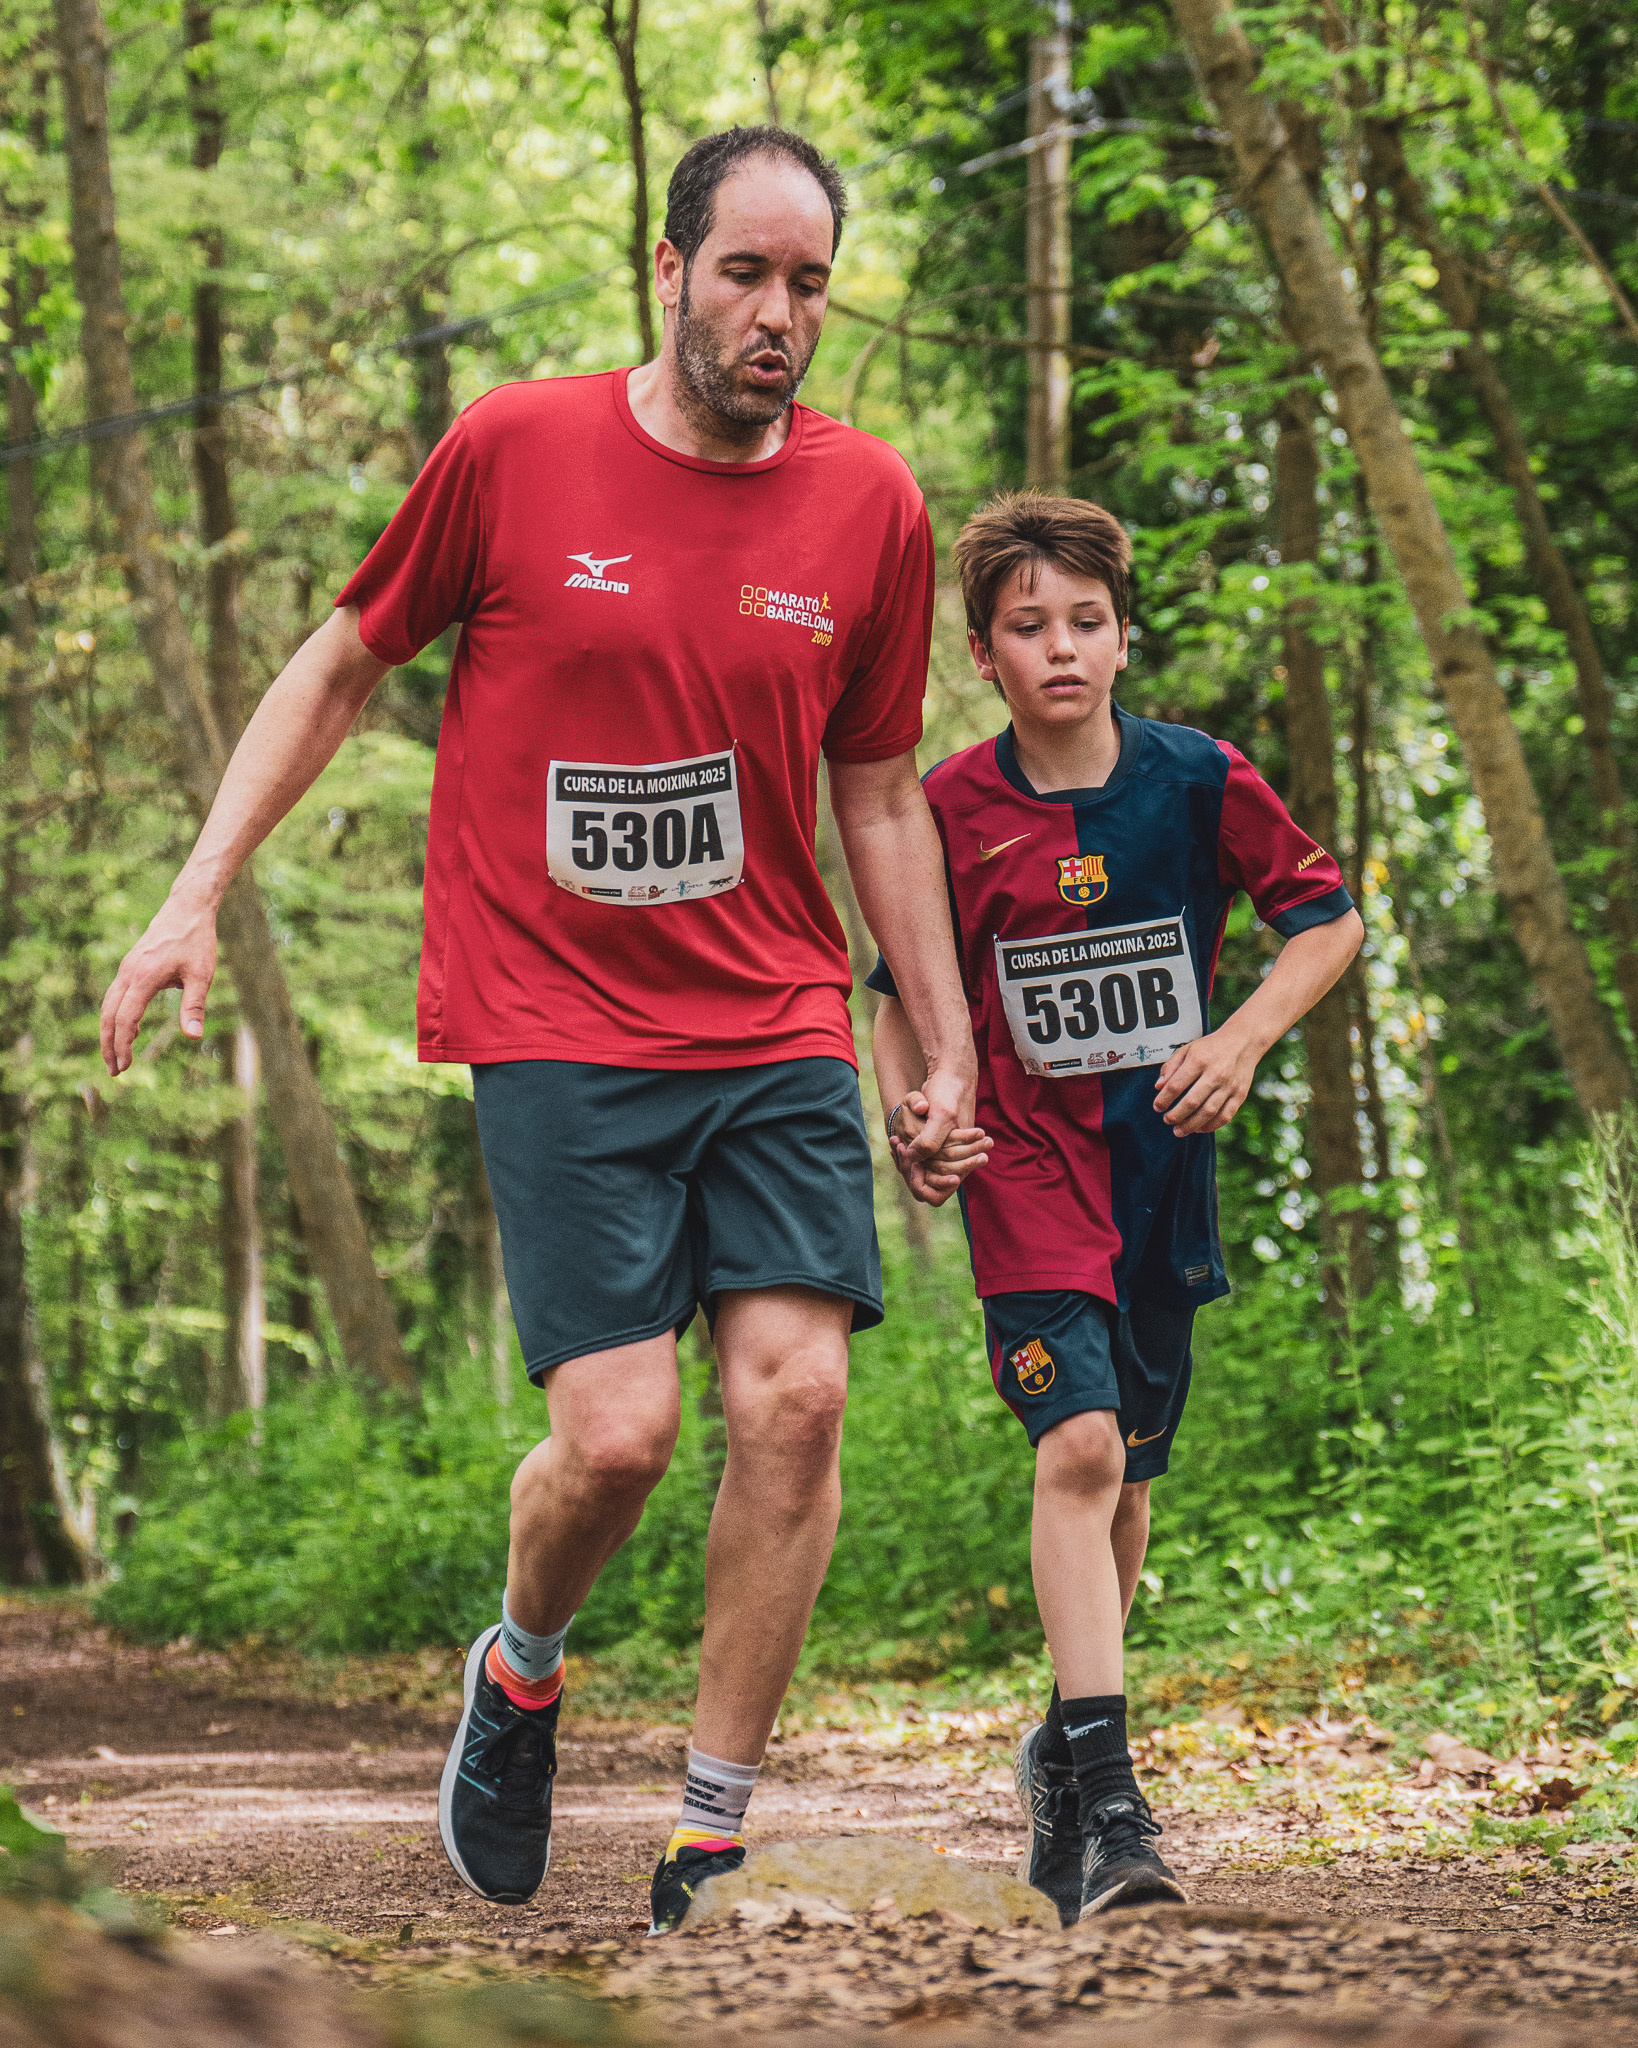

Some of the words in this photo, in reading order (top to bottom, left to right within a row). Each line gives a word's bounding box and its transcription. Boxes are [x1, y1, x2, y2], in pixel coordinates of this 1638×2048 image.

[767, 590, 819, 613] MARATÓ
[766, 605, 834, 633] BARCELONA
[811, 630, 833, 647] 2009
[563, 776, 606, 793] CURSA
[608, 778, 626, 794] DE
[627, 779, 645, 794] LA
[647, 772, 698, 794] MOIXINA
[699, 766, 726, 785] 2025
[571, 802, 725, 871] 530A
[1010, 951, 1051, 970] CURSA
[1051, 949, 1069, 965] DE
[1070, 946, 1088, 962] LA
[1089, 936, 1145, 960] MOIXINA
[1146, 931, 1177, 950] 2025
[1022, 967, 1180, 1044] 530B
